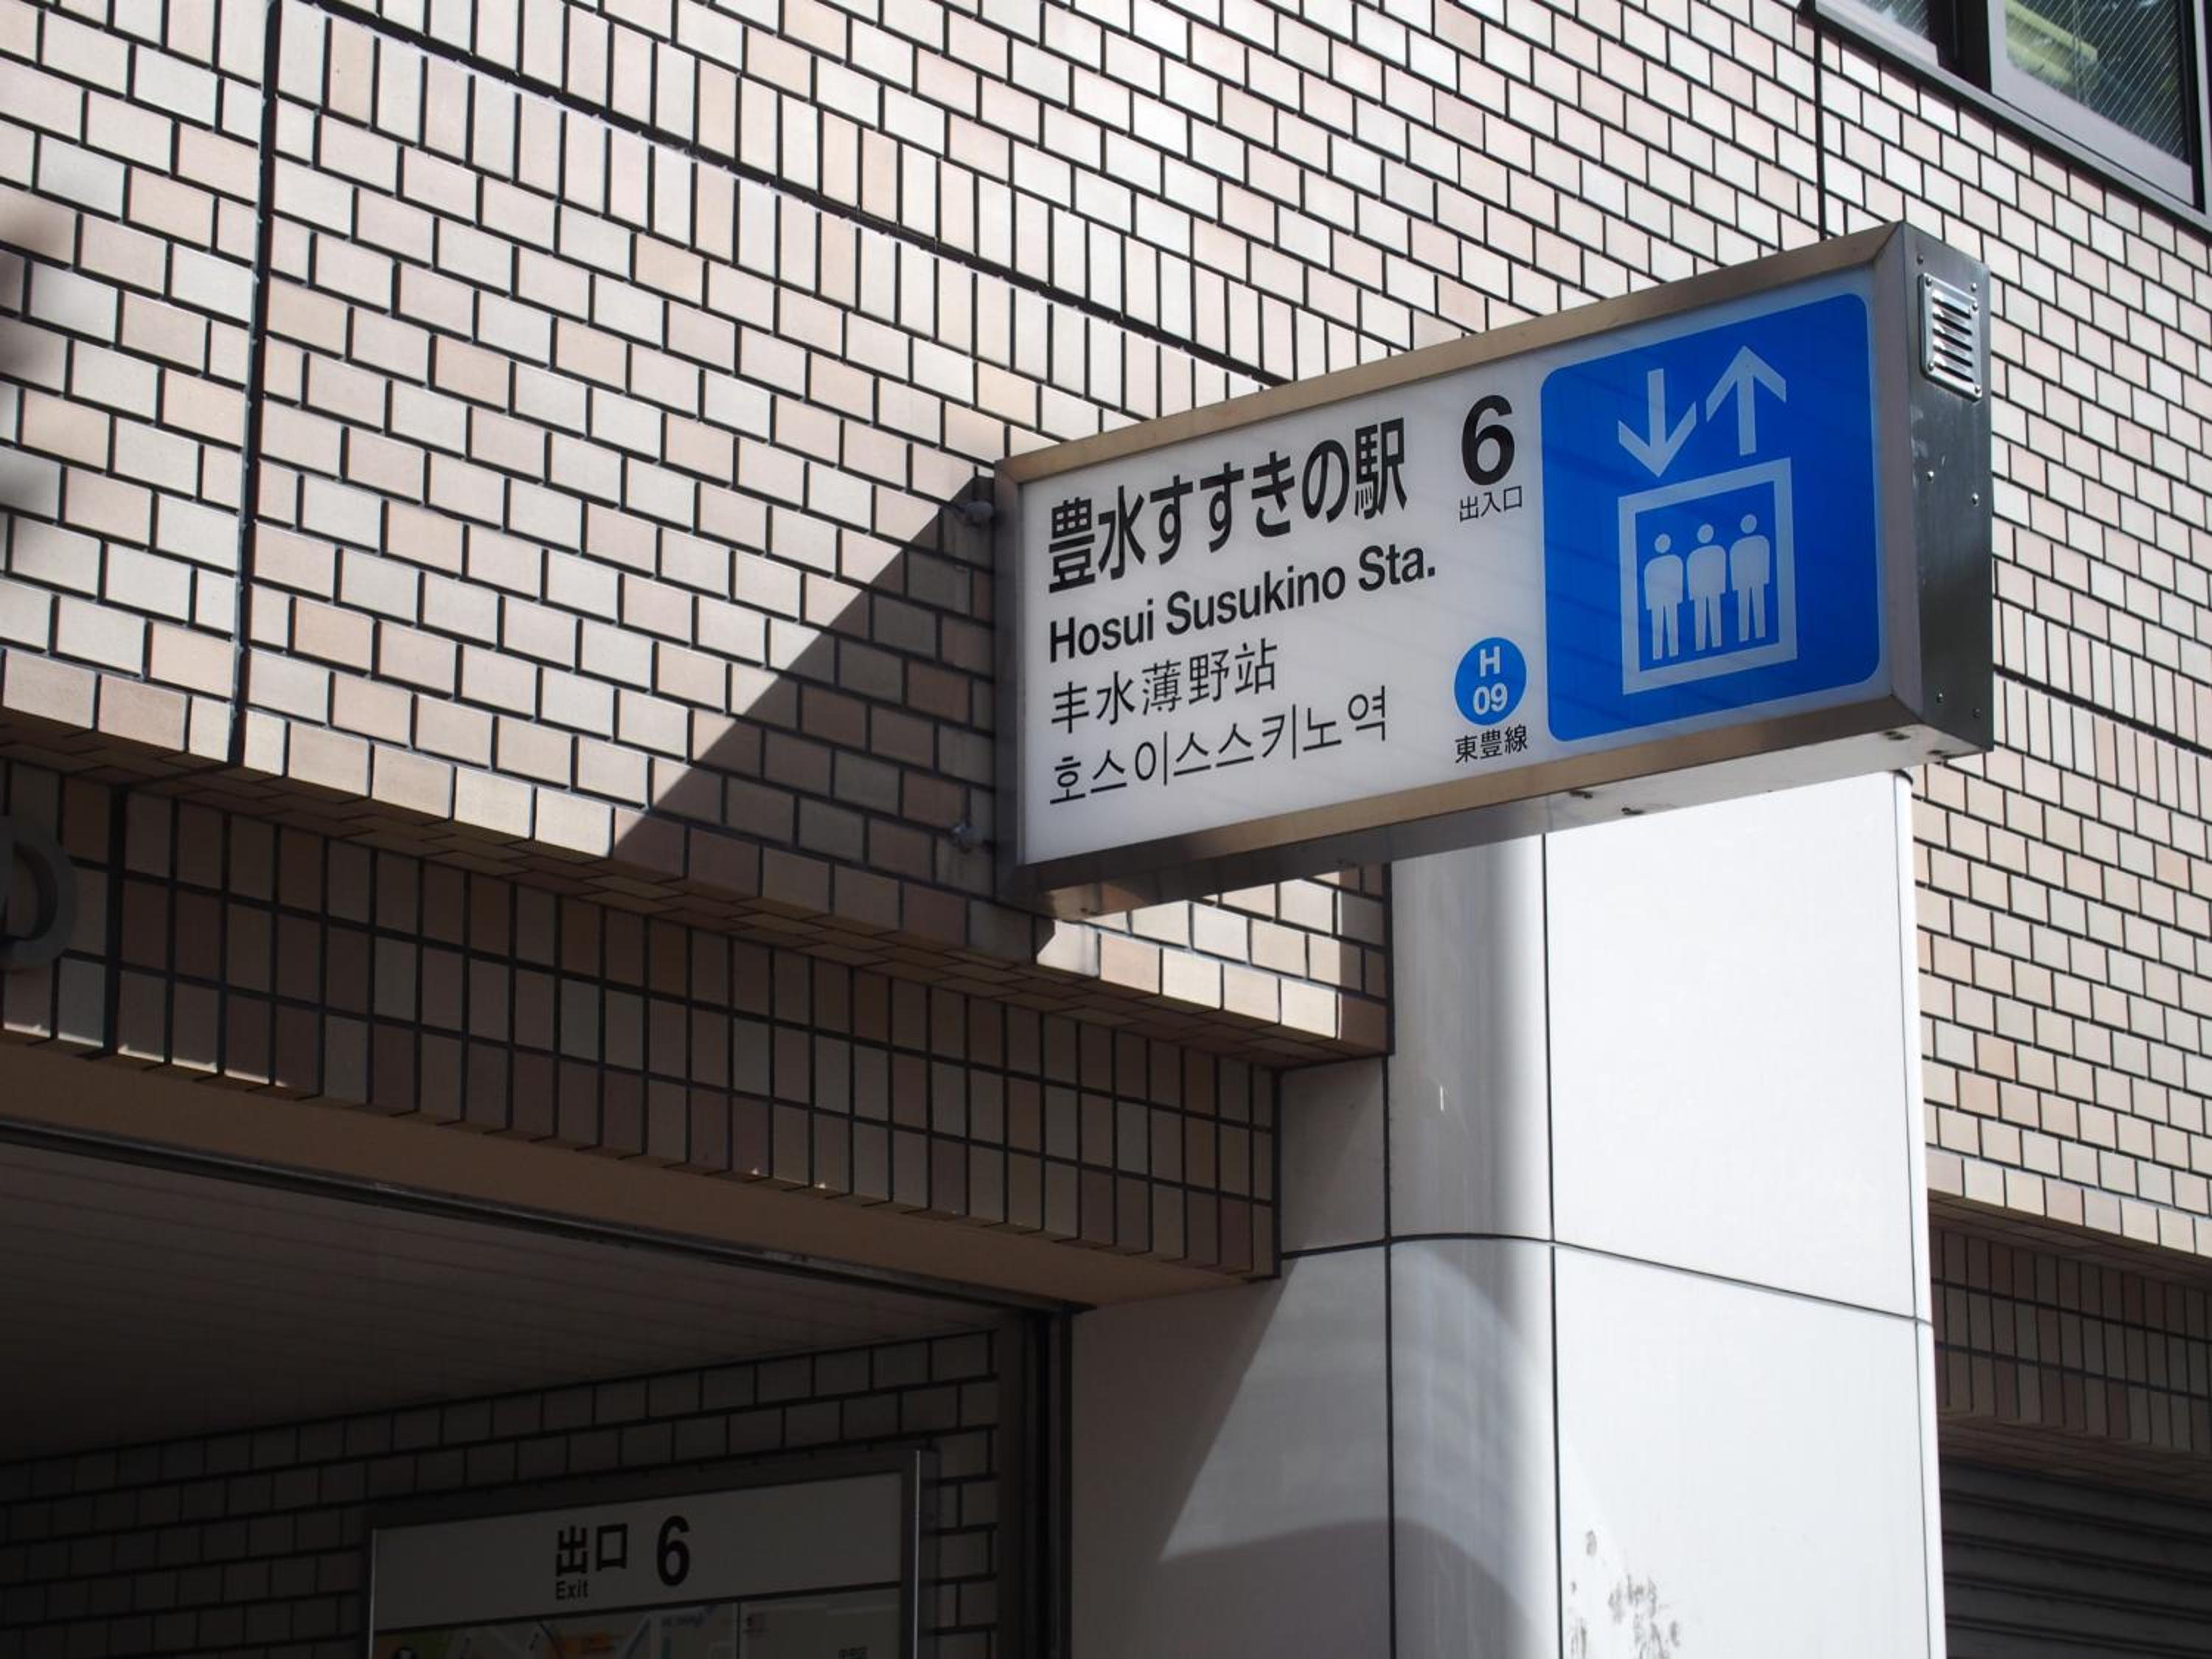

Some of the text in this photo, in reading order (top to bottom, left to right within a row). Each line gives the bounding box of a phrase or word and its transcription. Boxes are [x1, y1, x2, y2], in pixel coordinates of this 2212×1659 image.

[1461, 394, 1515, 486] 6
[1048, 417, 1407, 594] 豊水すすきの駅
[1459, 485, 1523, 523] 出入口
[1049, 543, 1436, 663] Hosui Susukino Sta.
[1051, 638, 1278, 735] 丰水薄野站
[1479, 644, 1501, 678] H
[1472, 682, 1509, 717] 09
[1049, 685, 1387, 804] 호스이스스키노역
[1455, 724, 1528, 764] 東豊線
[555, 1515, 691, 1586] 出口 6
[555, 1579, 589, 1601] Exit
